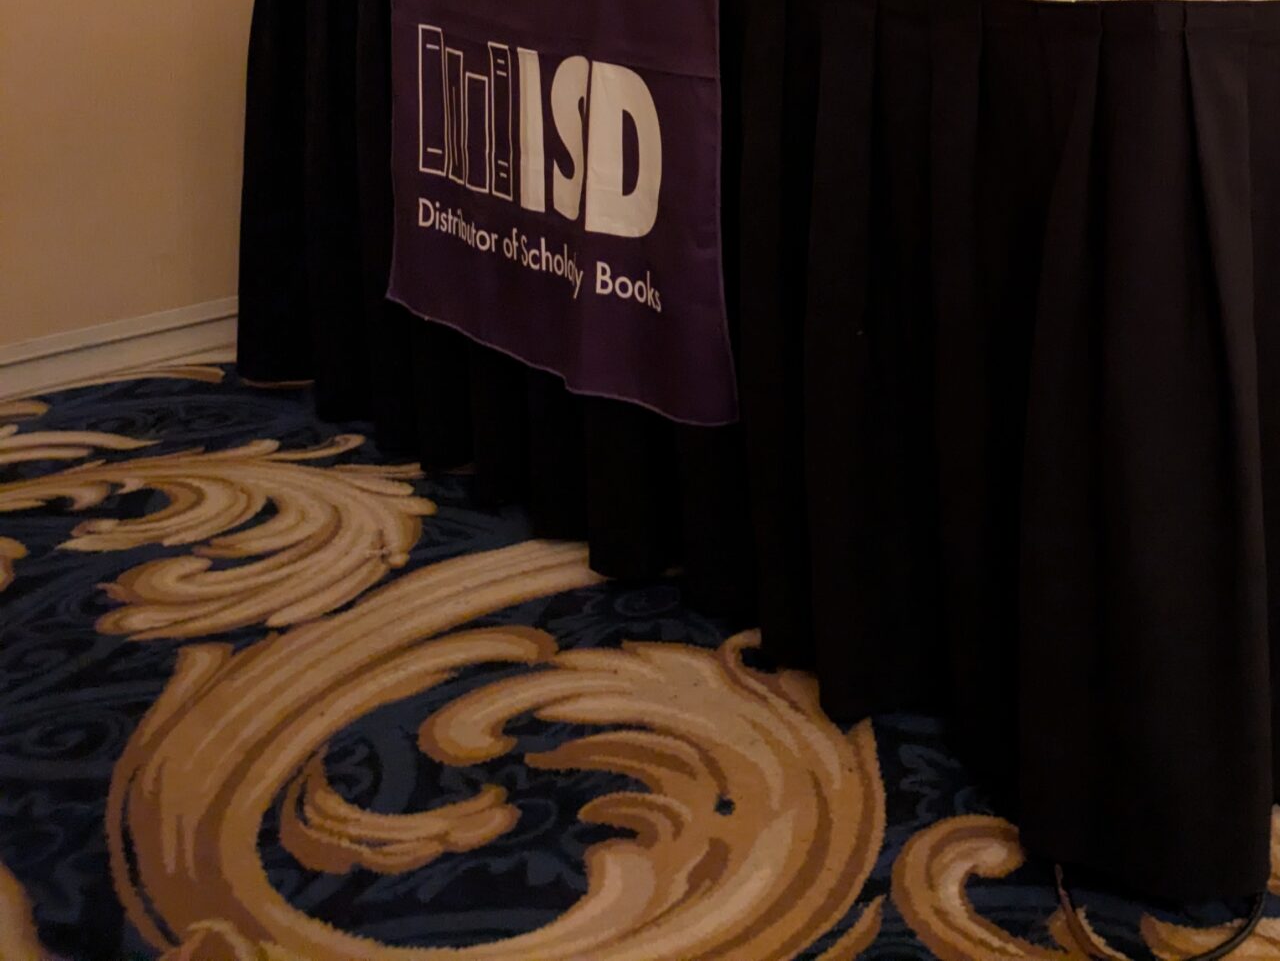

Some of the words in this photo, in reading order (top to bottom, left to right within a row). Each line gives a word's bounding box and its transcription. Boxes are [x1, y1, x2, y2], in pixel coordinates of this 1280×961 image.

[517, 46, 662, 238] ISD
[418, 197, 498, 252] Distributor
[503, 227, 518, 261] of
[520, 235, 584, 299] Scholaly
[596, 261, 662, 313] Books
